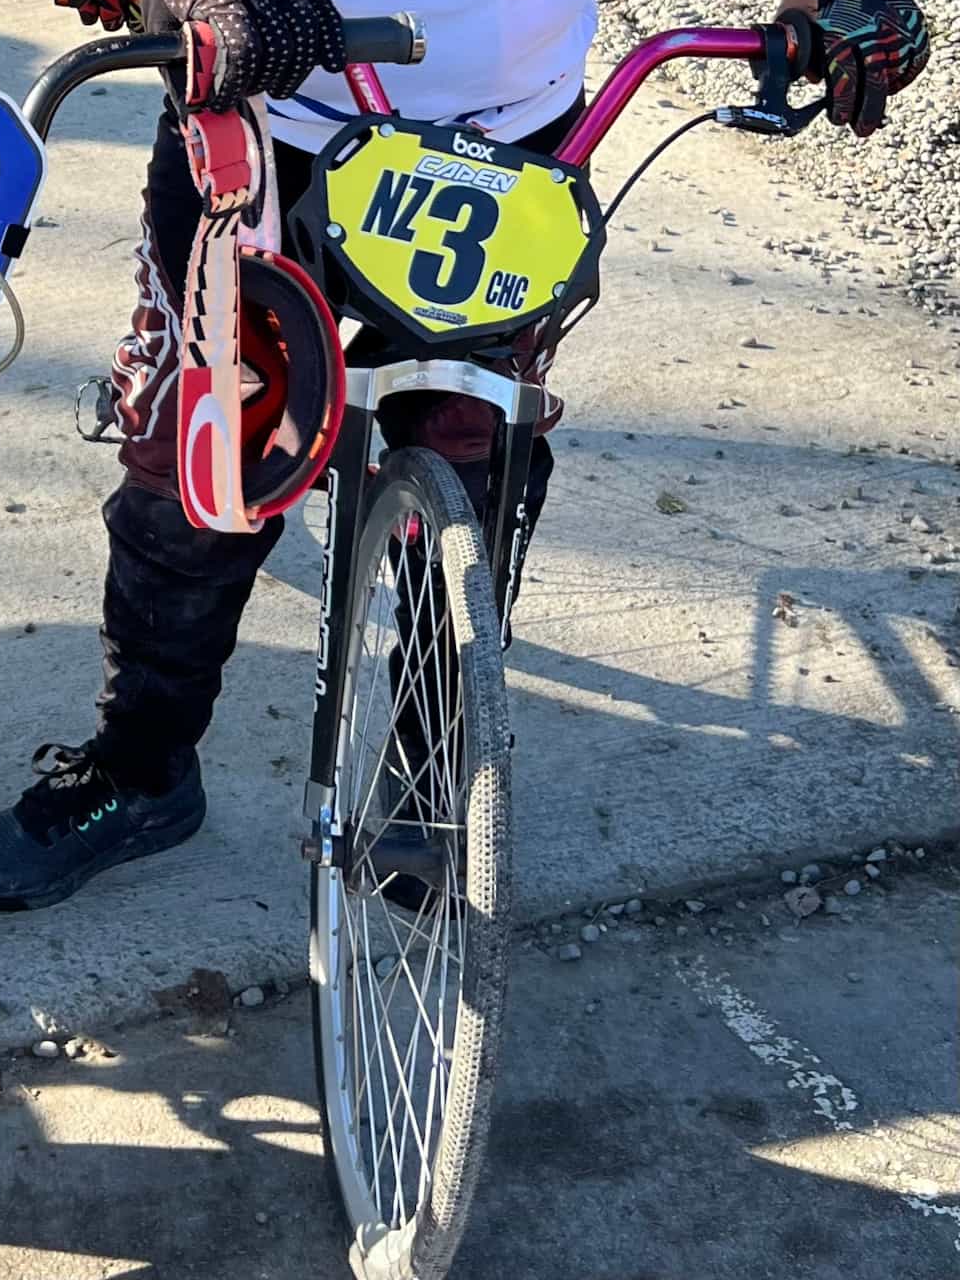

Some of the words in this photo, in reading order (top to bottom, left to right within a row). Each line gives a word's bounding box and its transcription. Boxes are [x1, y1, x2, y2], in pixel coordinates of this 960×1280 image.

[452, 133, 496, 162] box
[414, 156, 519, 193] CADEN
[360, 169, 434, 243] NZ
[408, 185, 500, 306] 3
[485, 270, 530, 310] CHC
